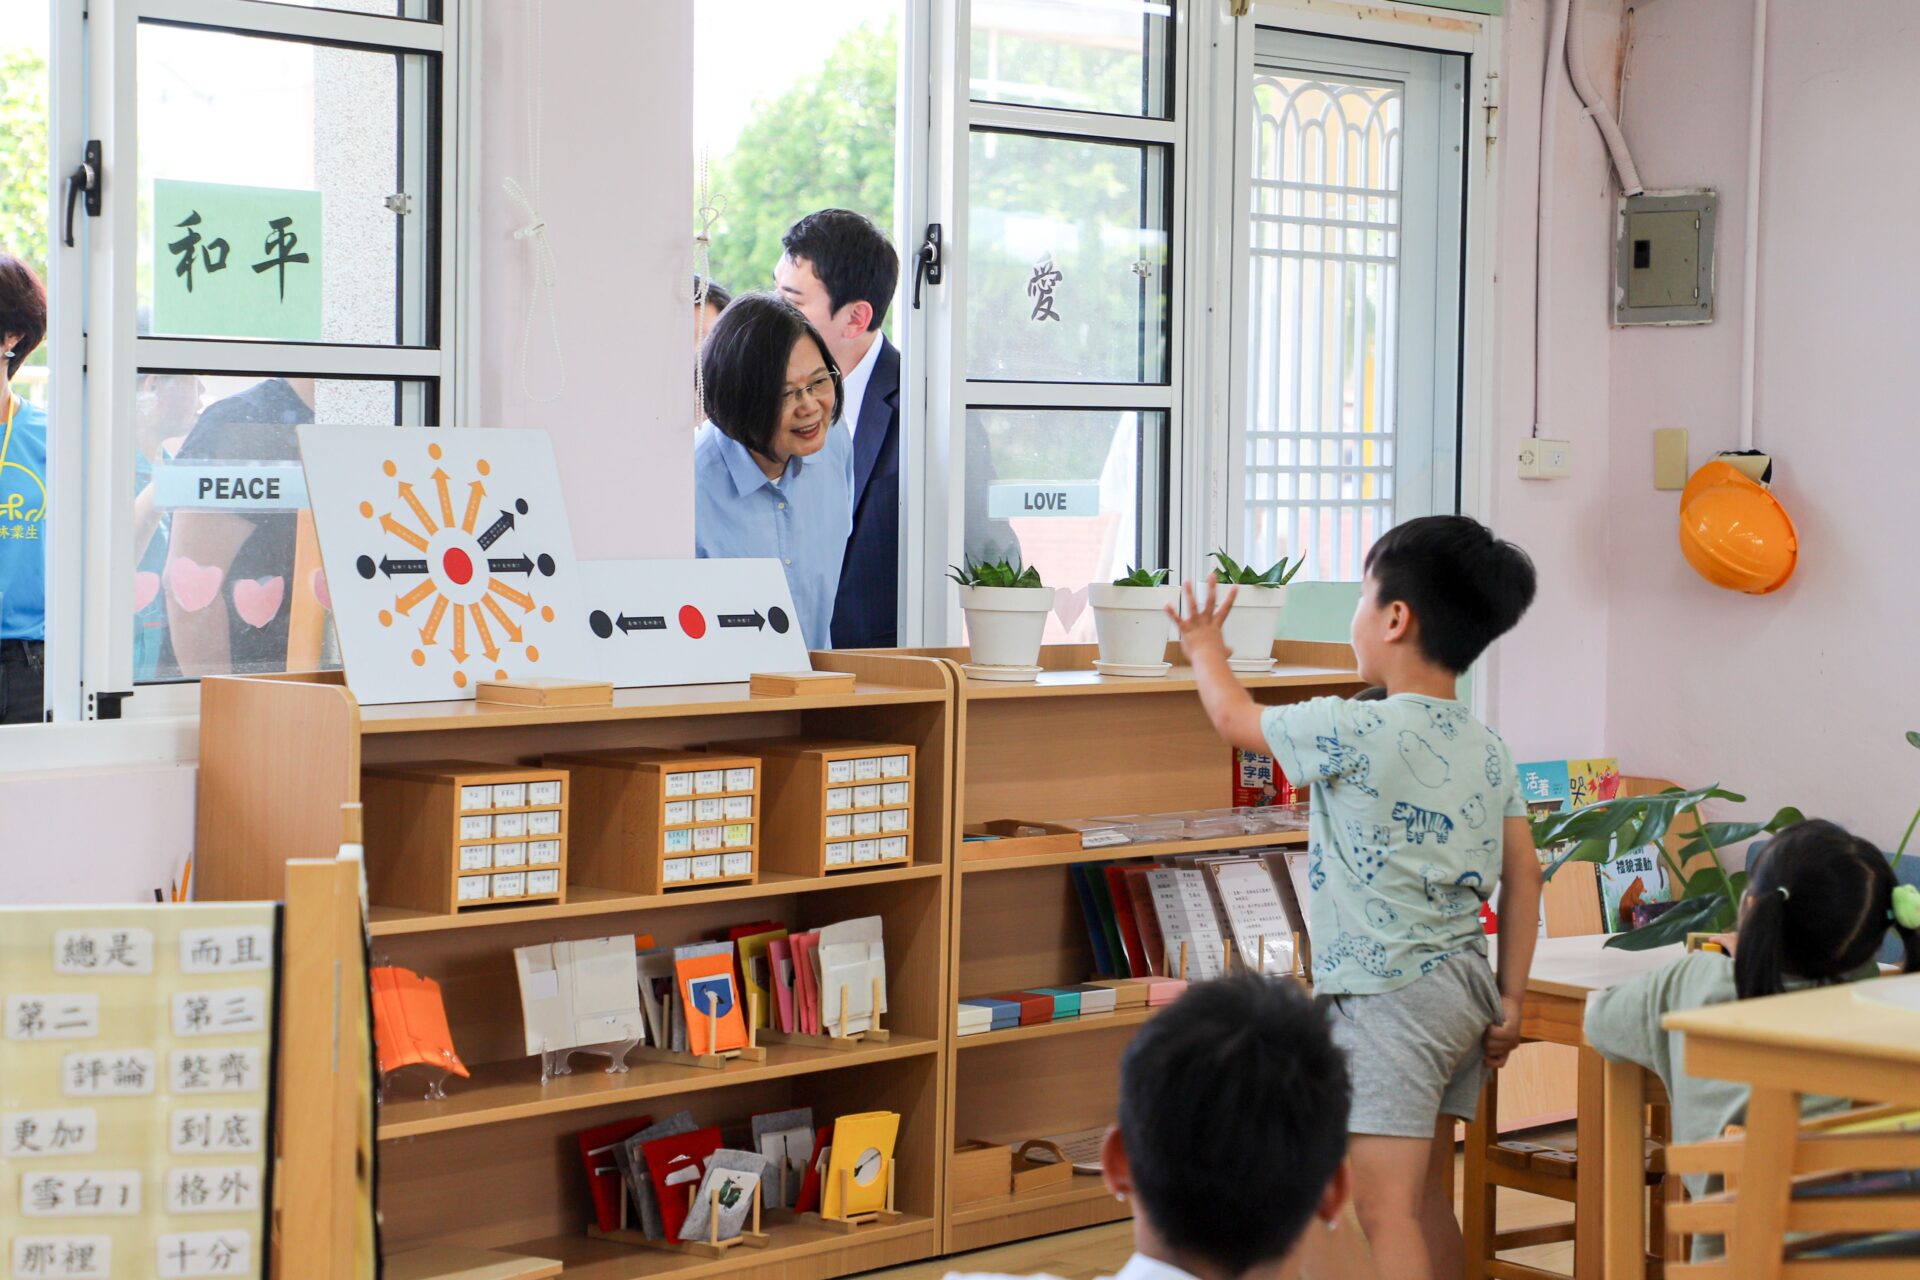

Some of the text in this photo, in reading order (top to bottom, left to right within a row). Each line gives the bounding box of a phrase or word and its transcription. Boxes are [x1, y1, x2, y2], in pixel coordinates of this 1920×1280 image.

[167, 209, 310, 304] 和平
[1027, 251, 1063, 322] 愛
[199, 477, 281, 500] PEACE
[1024, 492, 1067, 510] LOVE
[1243, 766, 1271, 780] 字典
[1616, 857, 1653, 874] 禮貌運動
[62, 933, 138, 968] 總是
[191, 935, 263, 966] 而且
[16, 1001, 90, 1037] 第二
[183, 997, 253, 1031] 第三
[71, 1057, 147, 1089] 評論
[181, 1053, 250, 1089] 整齊
[12, 1119, 85, 1151] 更加
[181, 1115, 251, 1148] 到底
[176, 1170, 249, 1206] 格外
[22, 1242, 97, 1274] 那裡
[165, 1238, 240, 1271] 十分
